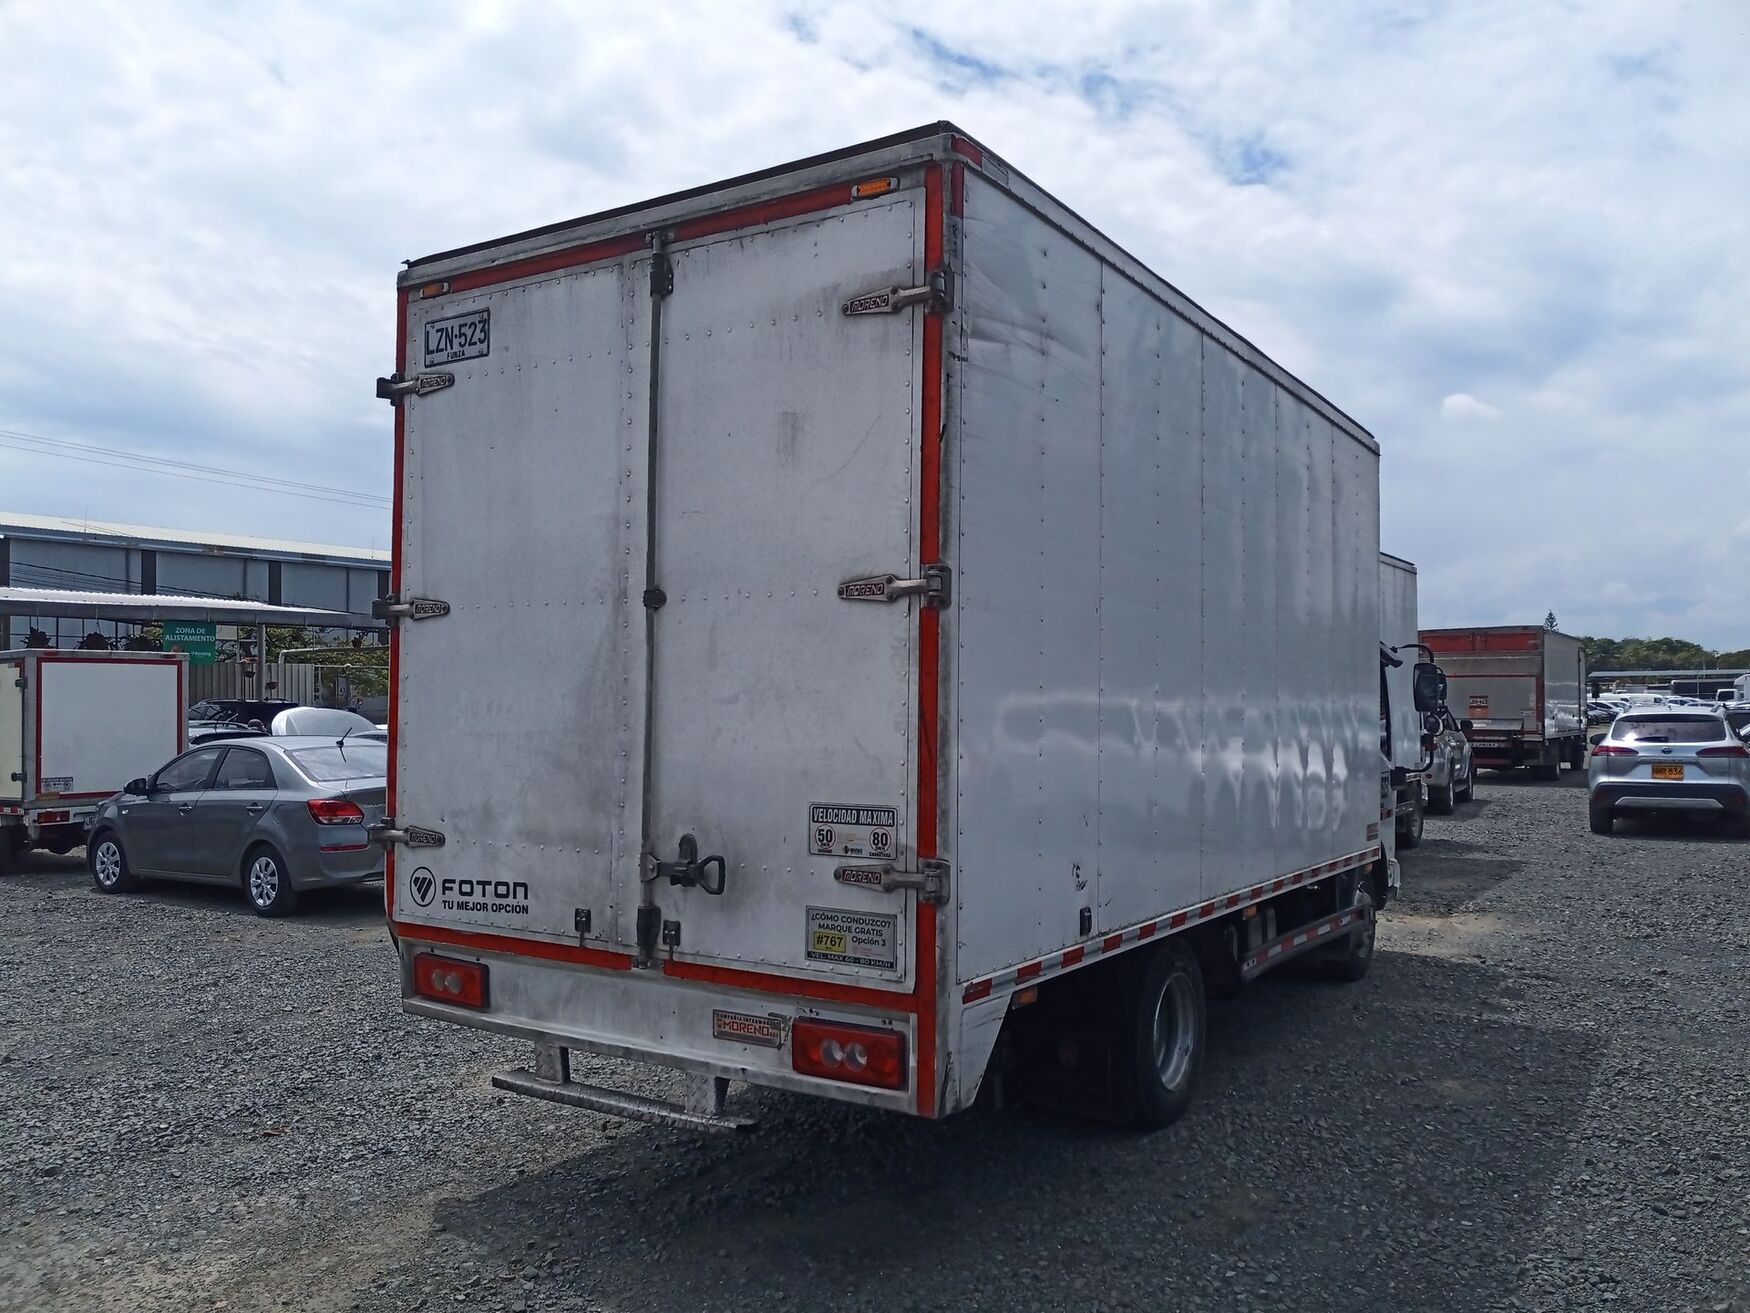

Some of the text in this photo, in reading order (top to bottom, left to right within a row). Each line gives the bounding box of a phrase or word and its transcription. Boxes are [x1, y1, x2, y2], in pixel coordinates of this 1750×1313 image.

[851, 295, 888, 312] MORENO
[447, 350, 466, 360] FUNZA
[846, 584, 884, 596] MORENO
[165, 634, 215, 642] ALISTAMIENTO
[814, 808, 894, 826] VELOCIDAD MAXIMA
[818, 828, 833, 843] 50
[872, 832, 888, 847] 80
[844, 870, 881, 884] MORENO
[442, 879, 528, 900] FOTON
[442, 900, 529, 914] TU MEJOR OPCIÓN
[812, 912, 891, 928] ¿CÓMO CONDUZCO?
[818, 923, 883, 937] MARQUE GRATIS
[816, 934, 843, 948] #767
[852, 936, 886, 947] Opción 3
[723, 1020, 769, 1036] MORENO
